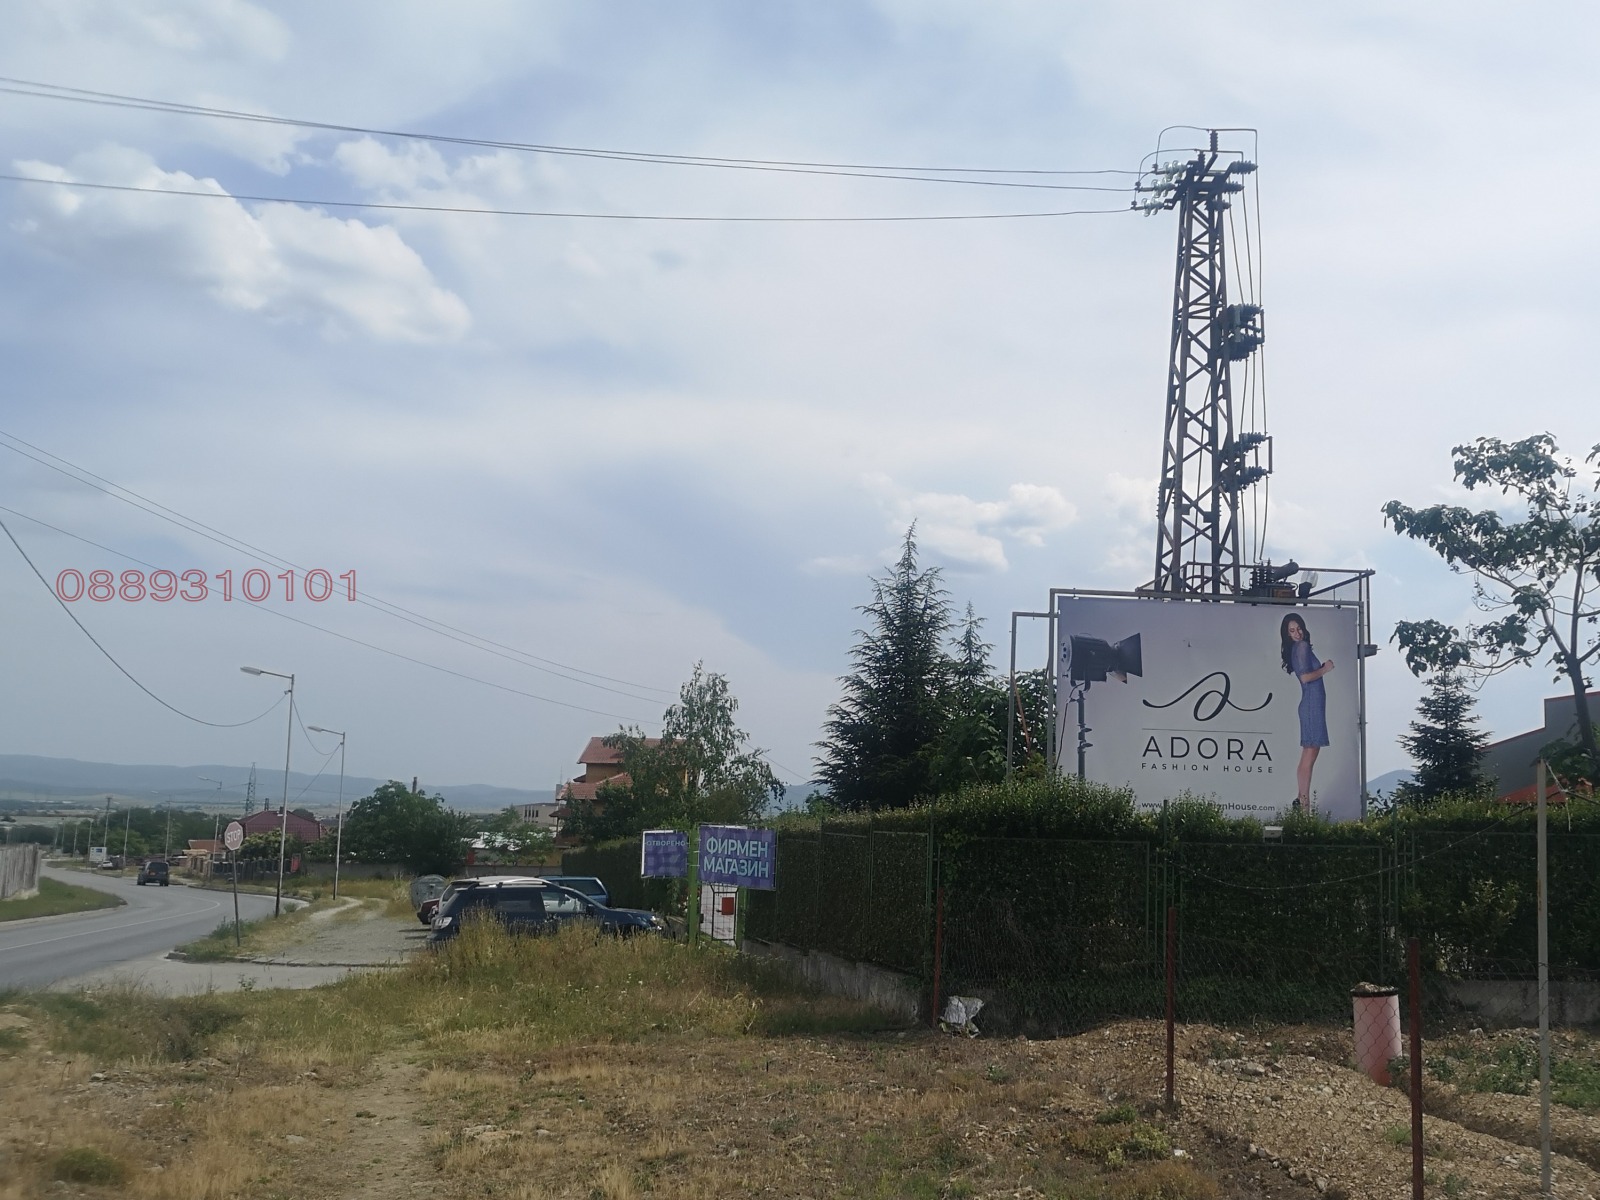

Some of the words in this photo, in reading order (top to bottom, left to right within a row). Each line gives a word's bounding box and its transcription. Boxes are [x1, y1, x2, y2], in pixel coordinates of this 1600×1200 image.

[1142, 735, 1273, 761] ADORA
[1141, 762, 1209, 771] FASHION
[1223, 765, 1273, 774] HOUSE
[227, 829, 241, 843] STOP
[706, 836, 769, 858] ФИРМЕН
[703, 856, 769, 878] МАГАЗИН
